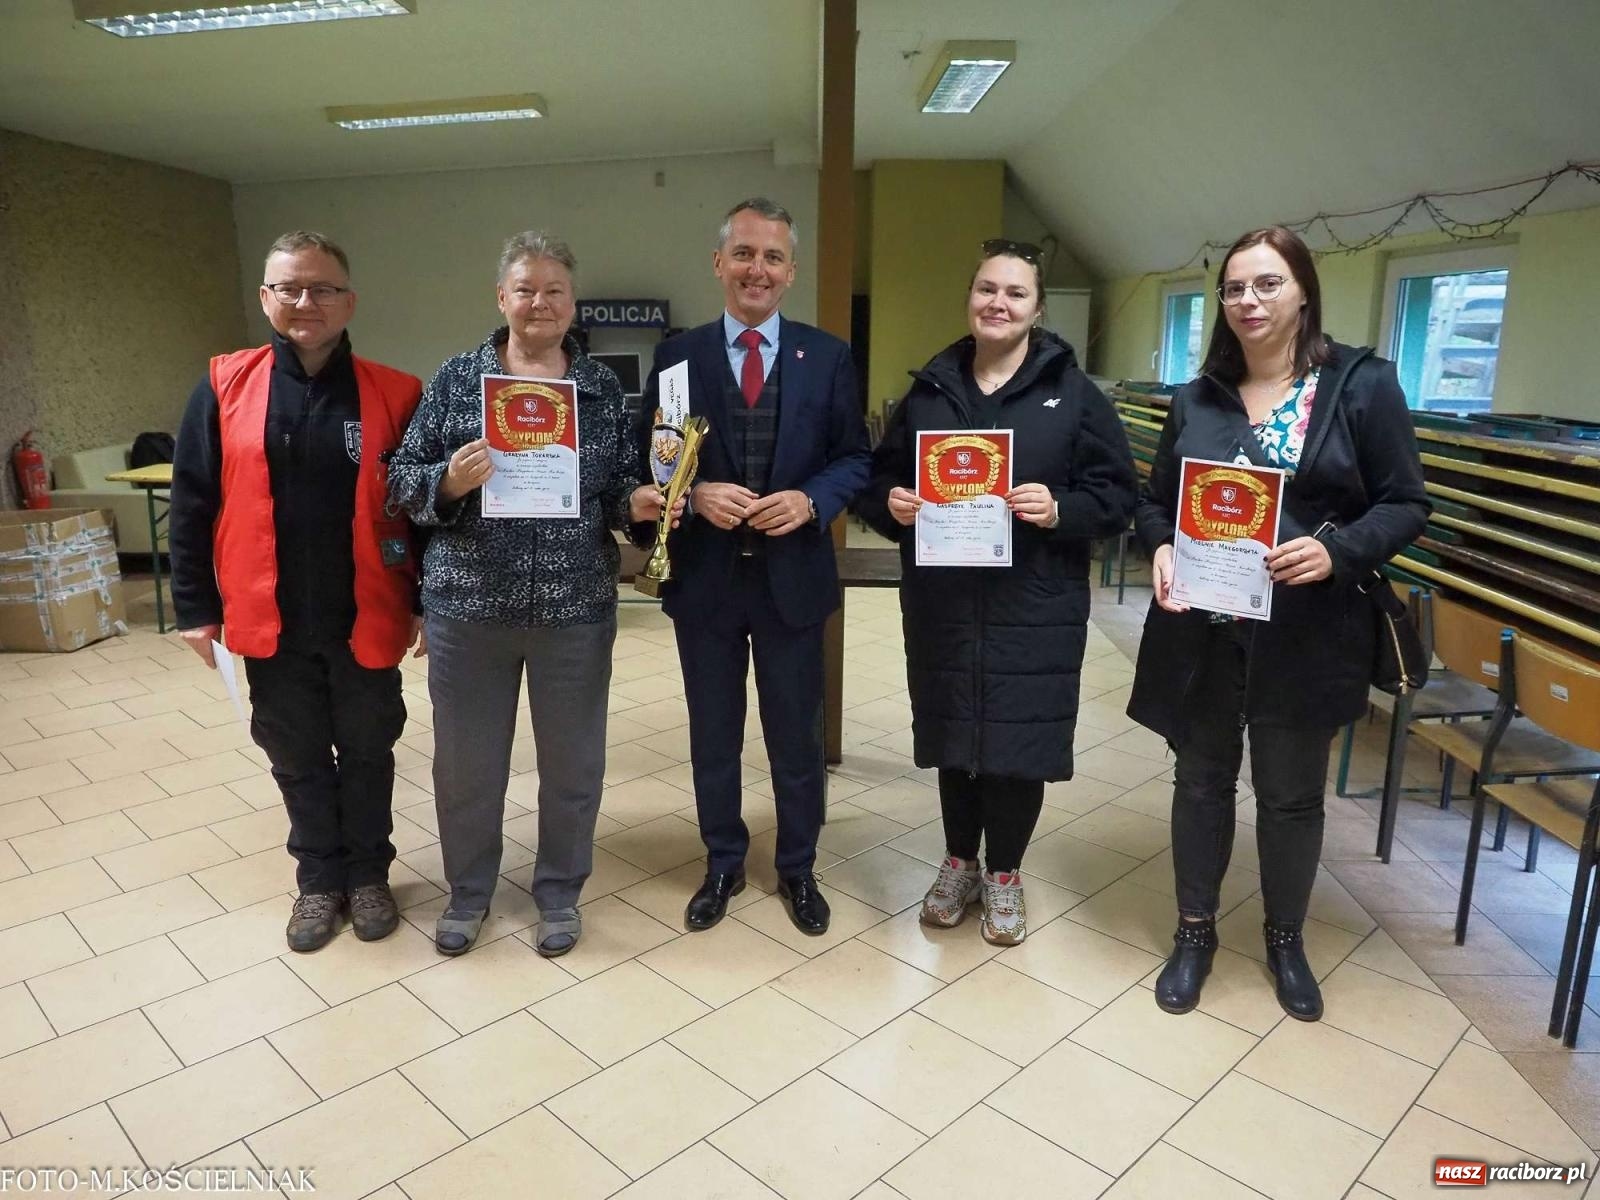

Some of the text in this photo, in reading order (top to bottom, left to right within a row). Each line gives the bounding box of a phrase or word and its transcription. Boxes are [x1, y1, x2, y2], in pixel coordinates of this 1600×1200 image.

[581, 306, 665, 322] POLICJA
[516, 415, 546, 424] Racibórz
[509, 431, 553, 444] DYPLOM
[941, 483, 985, 495] DYPLOM
[1212, 503, 1243, 515] Racibórz
[1202, 520, 1248, 537] DYPLOM
